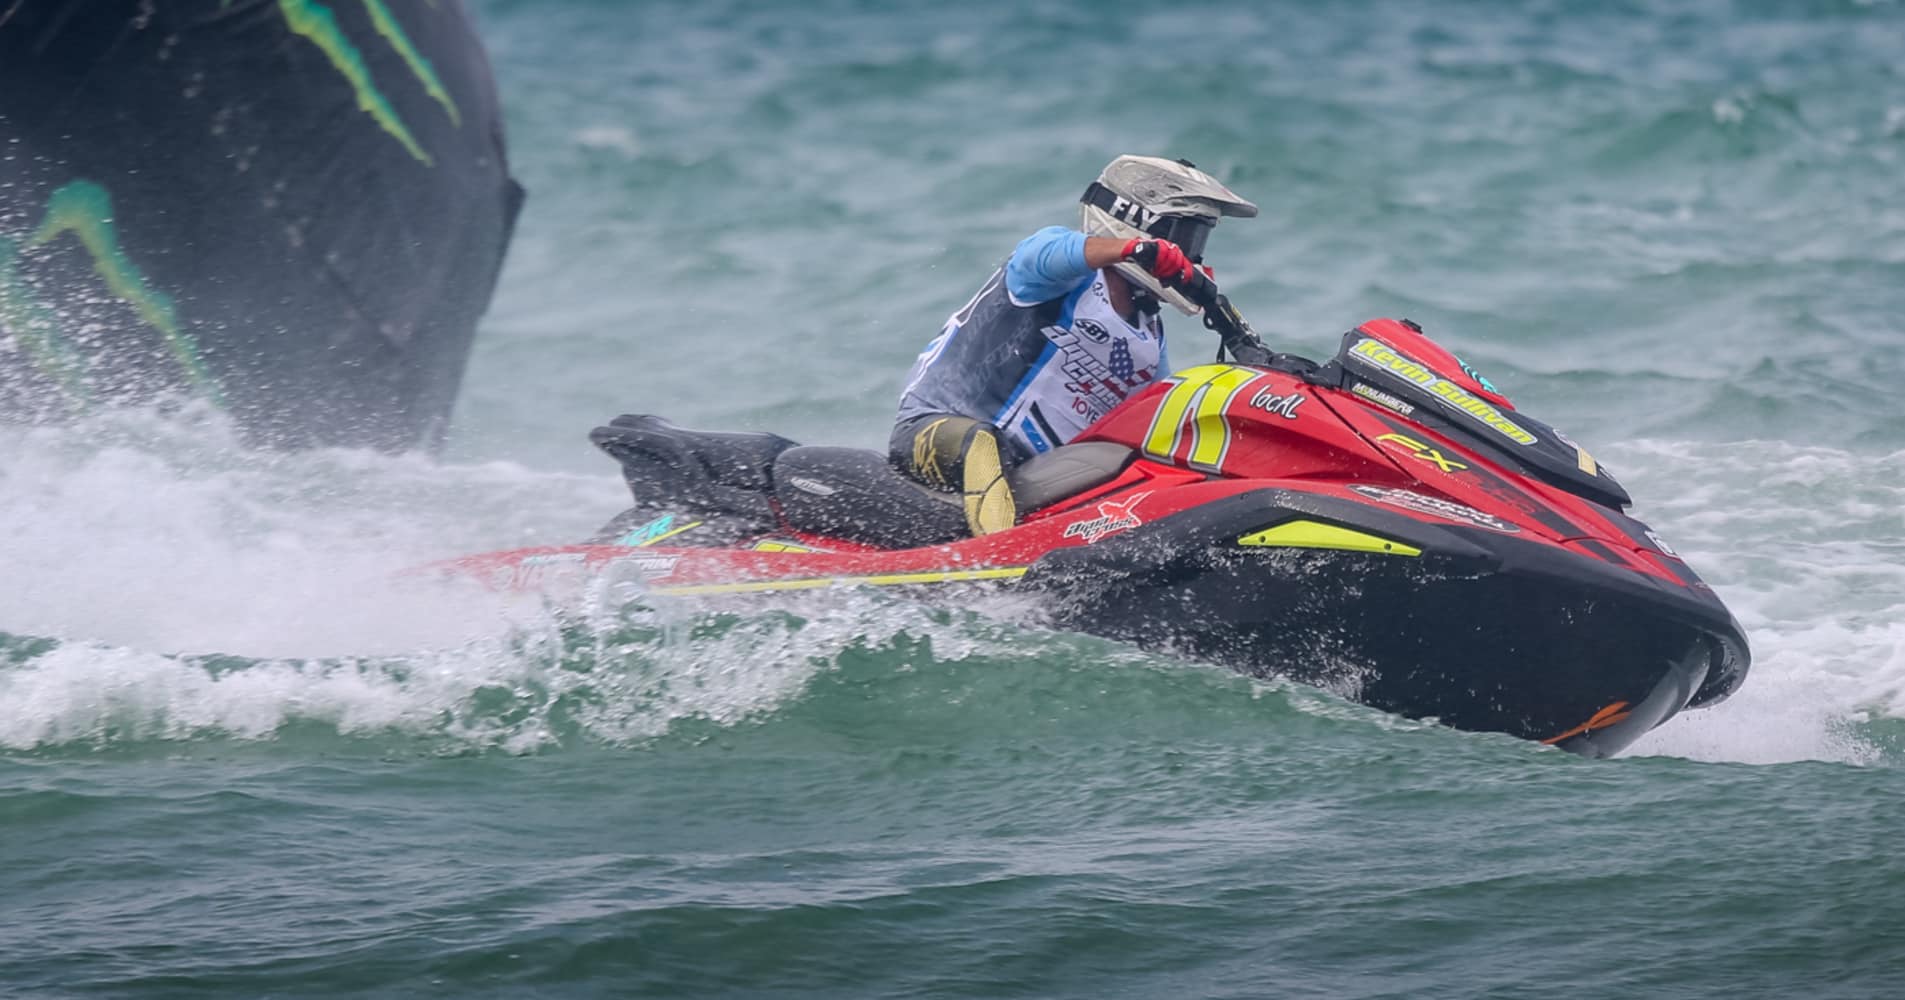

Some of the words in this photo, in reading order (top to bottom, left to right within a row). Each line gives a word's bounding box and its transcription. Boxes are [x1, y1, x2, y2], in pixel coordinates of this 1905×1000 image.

[1108, 196, 1161, 231] FLY
[1074, 318, 1110, 342] SBT
[1356, 339, 1433, 384] Kevin
[1428, 380, 1535, 443] Sullivan
[1376, 433, 1469, 473] FX
